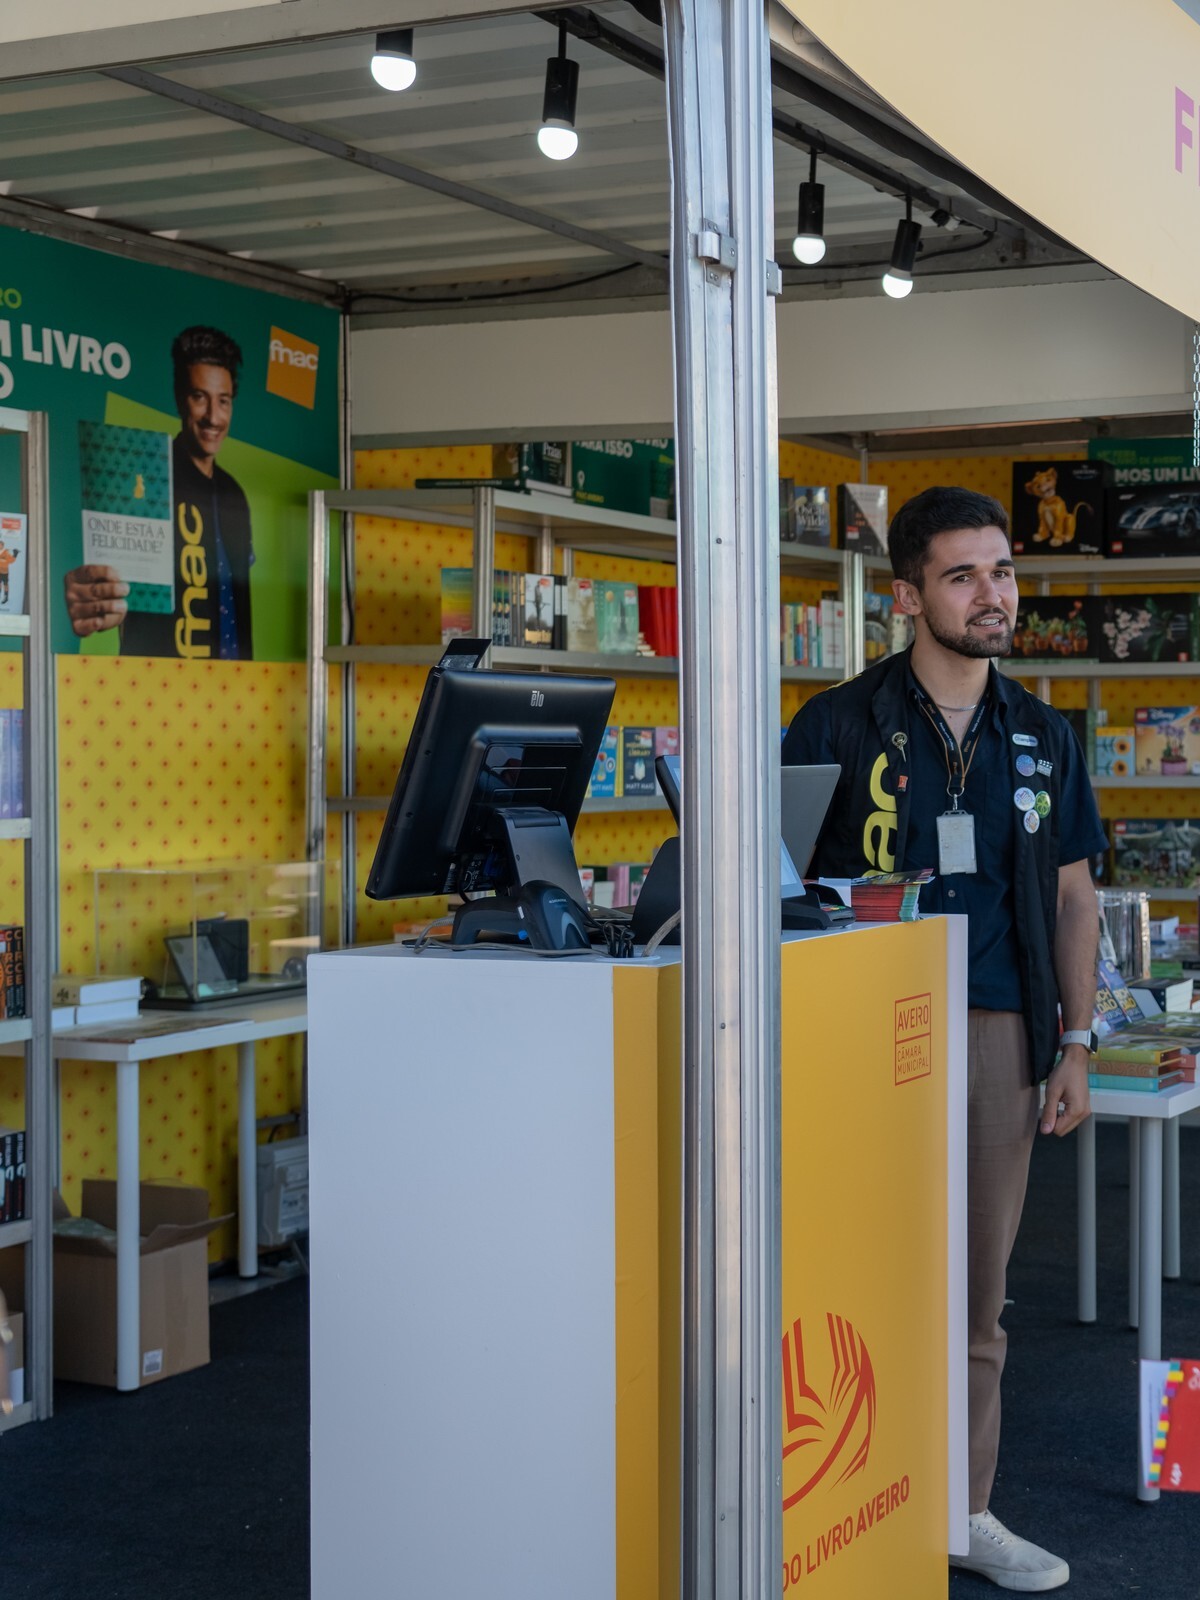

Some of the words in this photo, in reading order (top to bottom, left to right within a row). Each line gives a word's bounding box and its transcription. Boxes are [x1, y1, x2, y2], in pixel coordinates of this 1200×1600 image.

[0, 287, 22, 309] O
[21, 323, 131, 380] LIVRO
[269, 339, 318, 370] fnac
[605, 440, 633, 458] ISSO
[1154, 467, 1179, 482] UM
[87, 516, 122, 535] ONDE
[155, 525, 166, 539] A
[174, 502, 211, 659] fnac
[5, 929, 13, 987] CIRCE
[14, 927, 23, 986] CIRCE
[897, 1044, 922, 1062] CÂMARA
[897, 1056, 929, 1075] MUNICIPAL
[806, 1515, 854, 1575] LIVRO
[855, 1474, 910, 1538] AVEIRO
